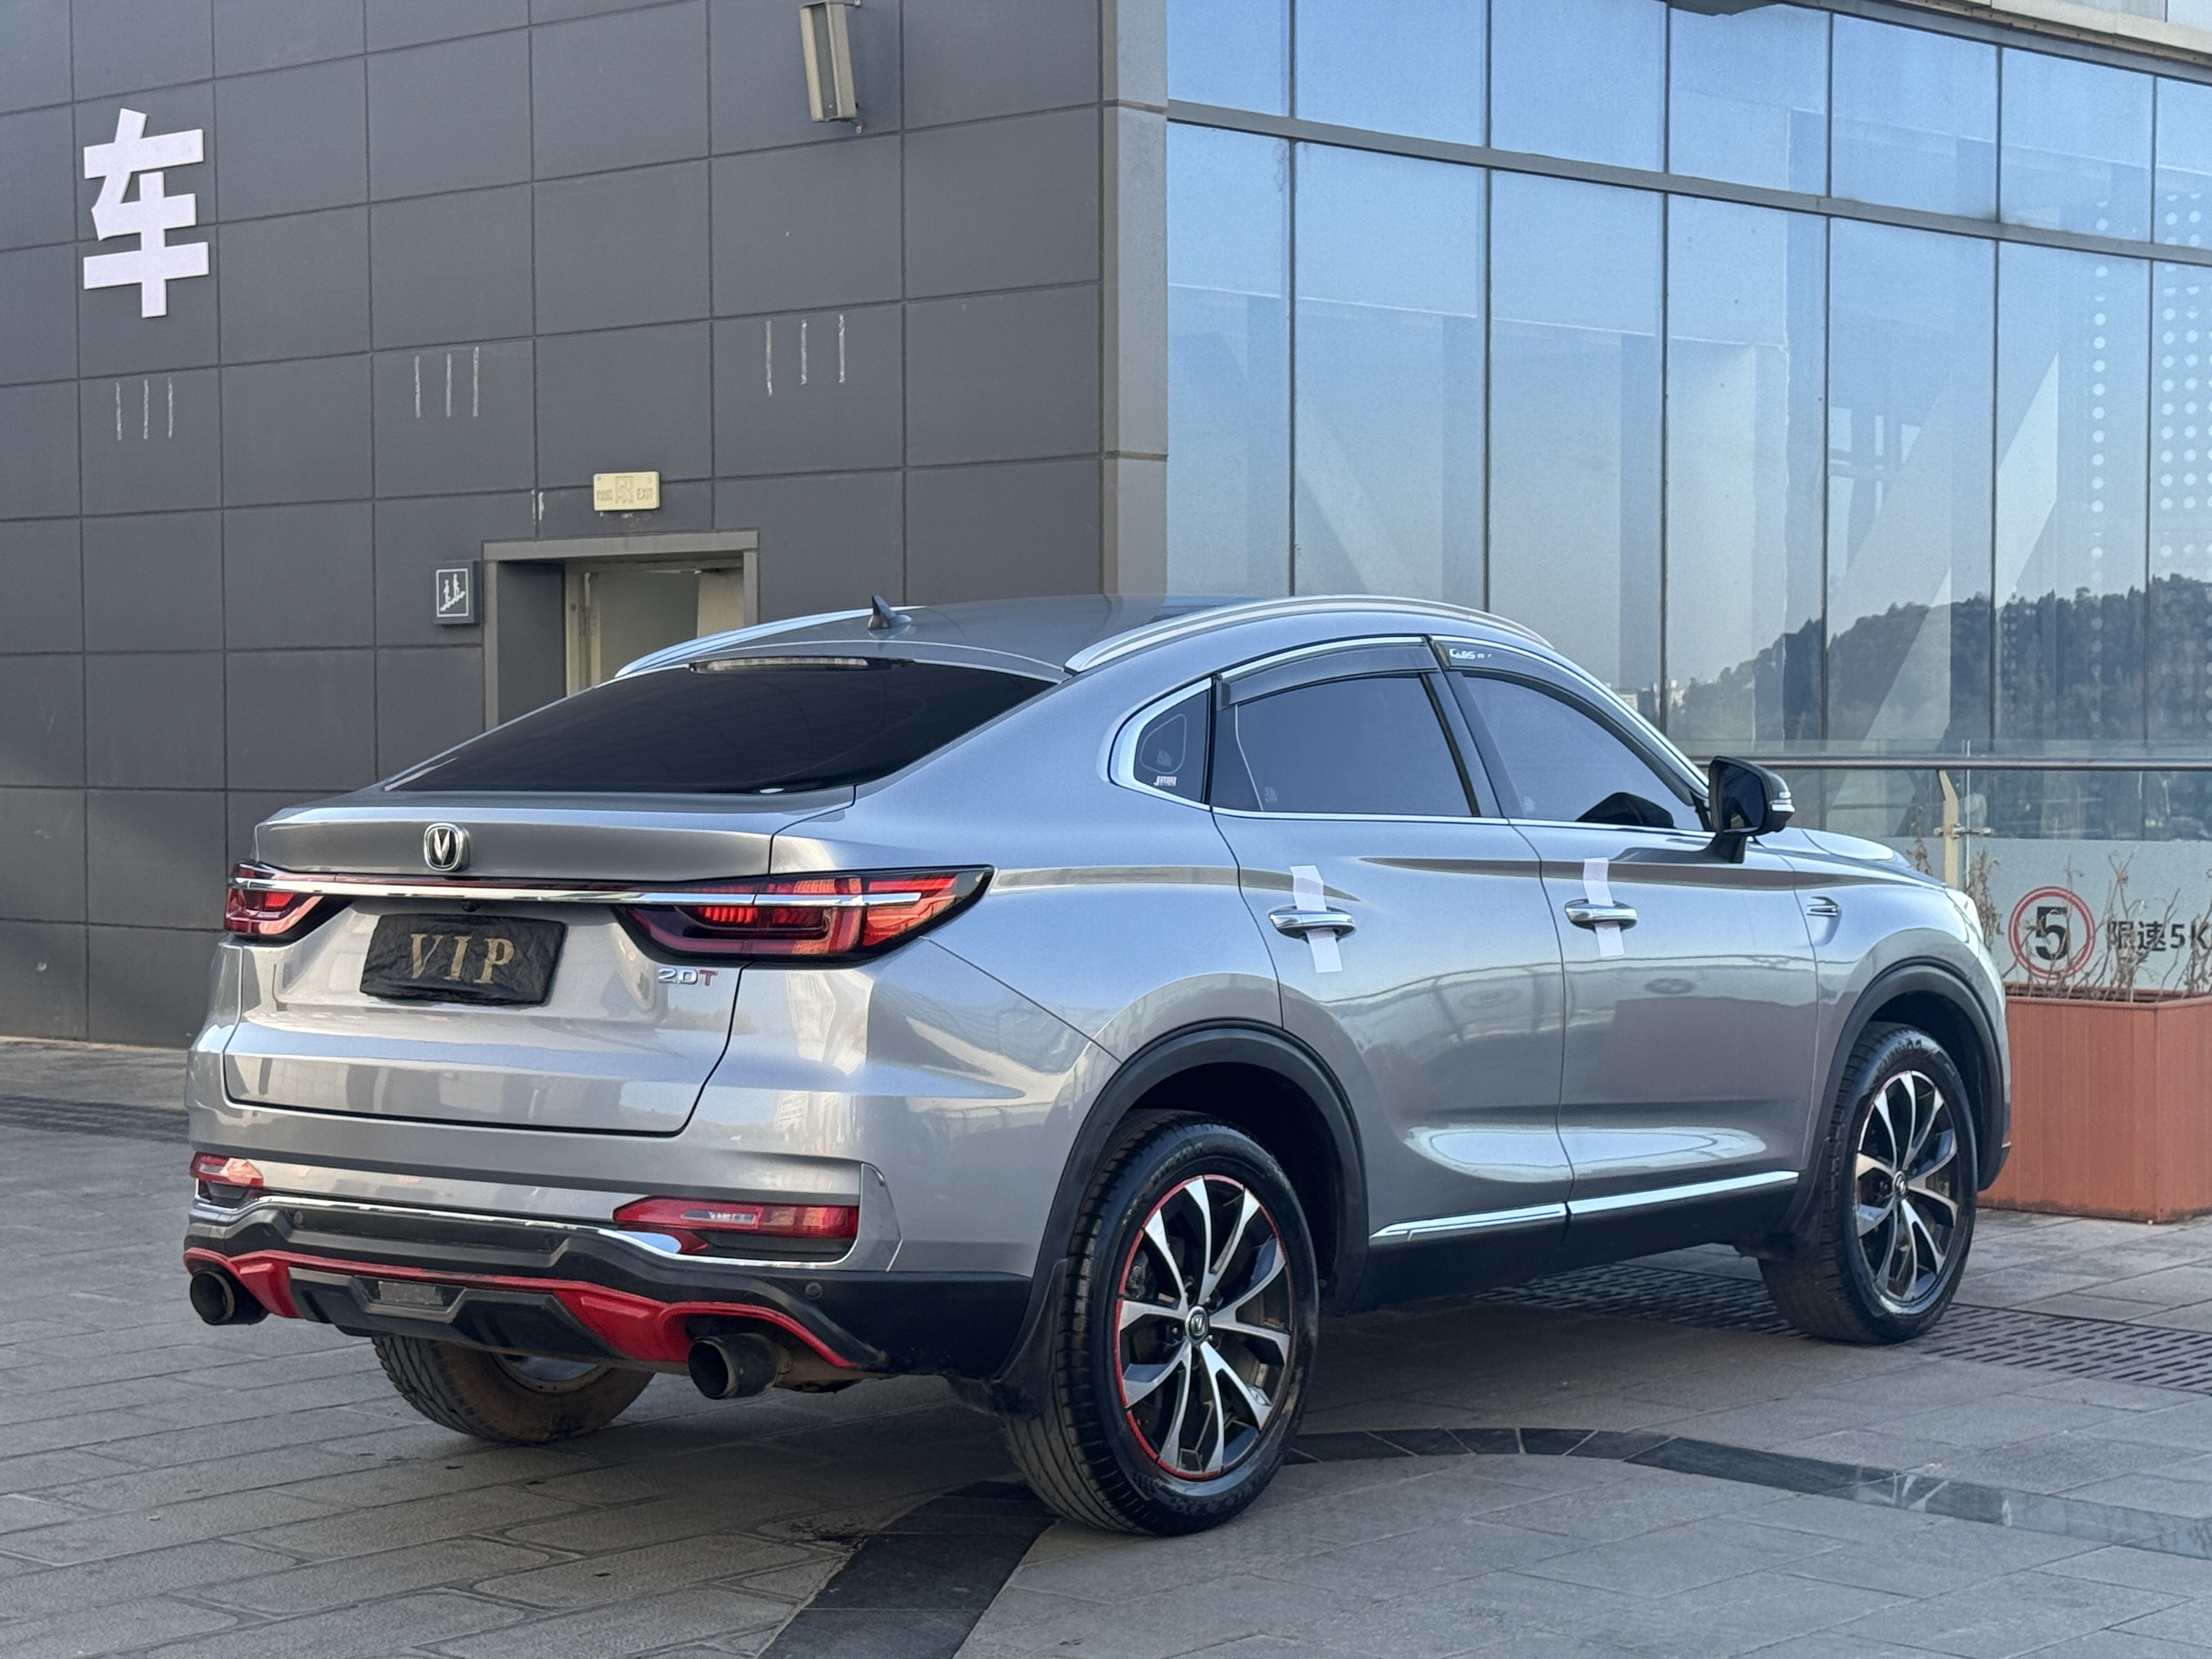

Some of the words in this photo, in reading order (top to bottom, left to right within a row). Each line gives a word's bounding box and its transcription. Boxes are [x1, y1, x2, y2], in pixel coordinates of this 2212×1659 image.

[83, 108, 210, 318] 车
[636, 487, 654, 500] EXIT
[410, 933, 515, 984] VIP
[2035, 906, 2068, 961] 5
[2107, 921, 2212, 952] 限速5K
